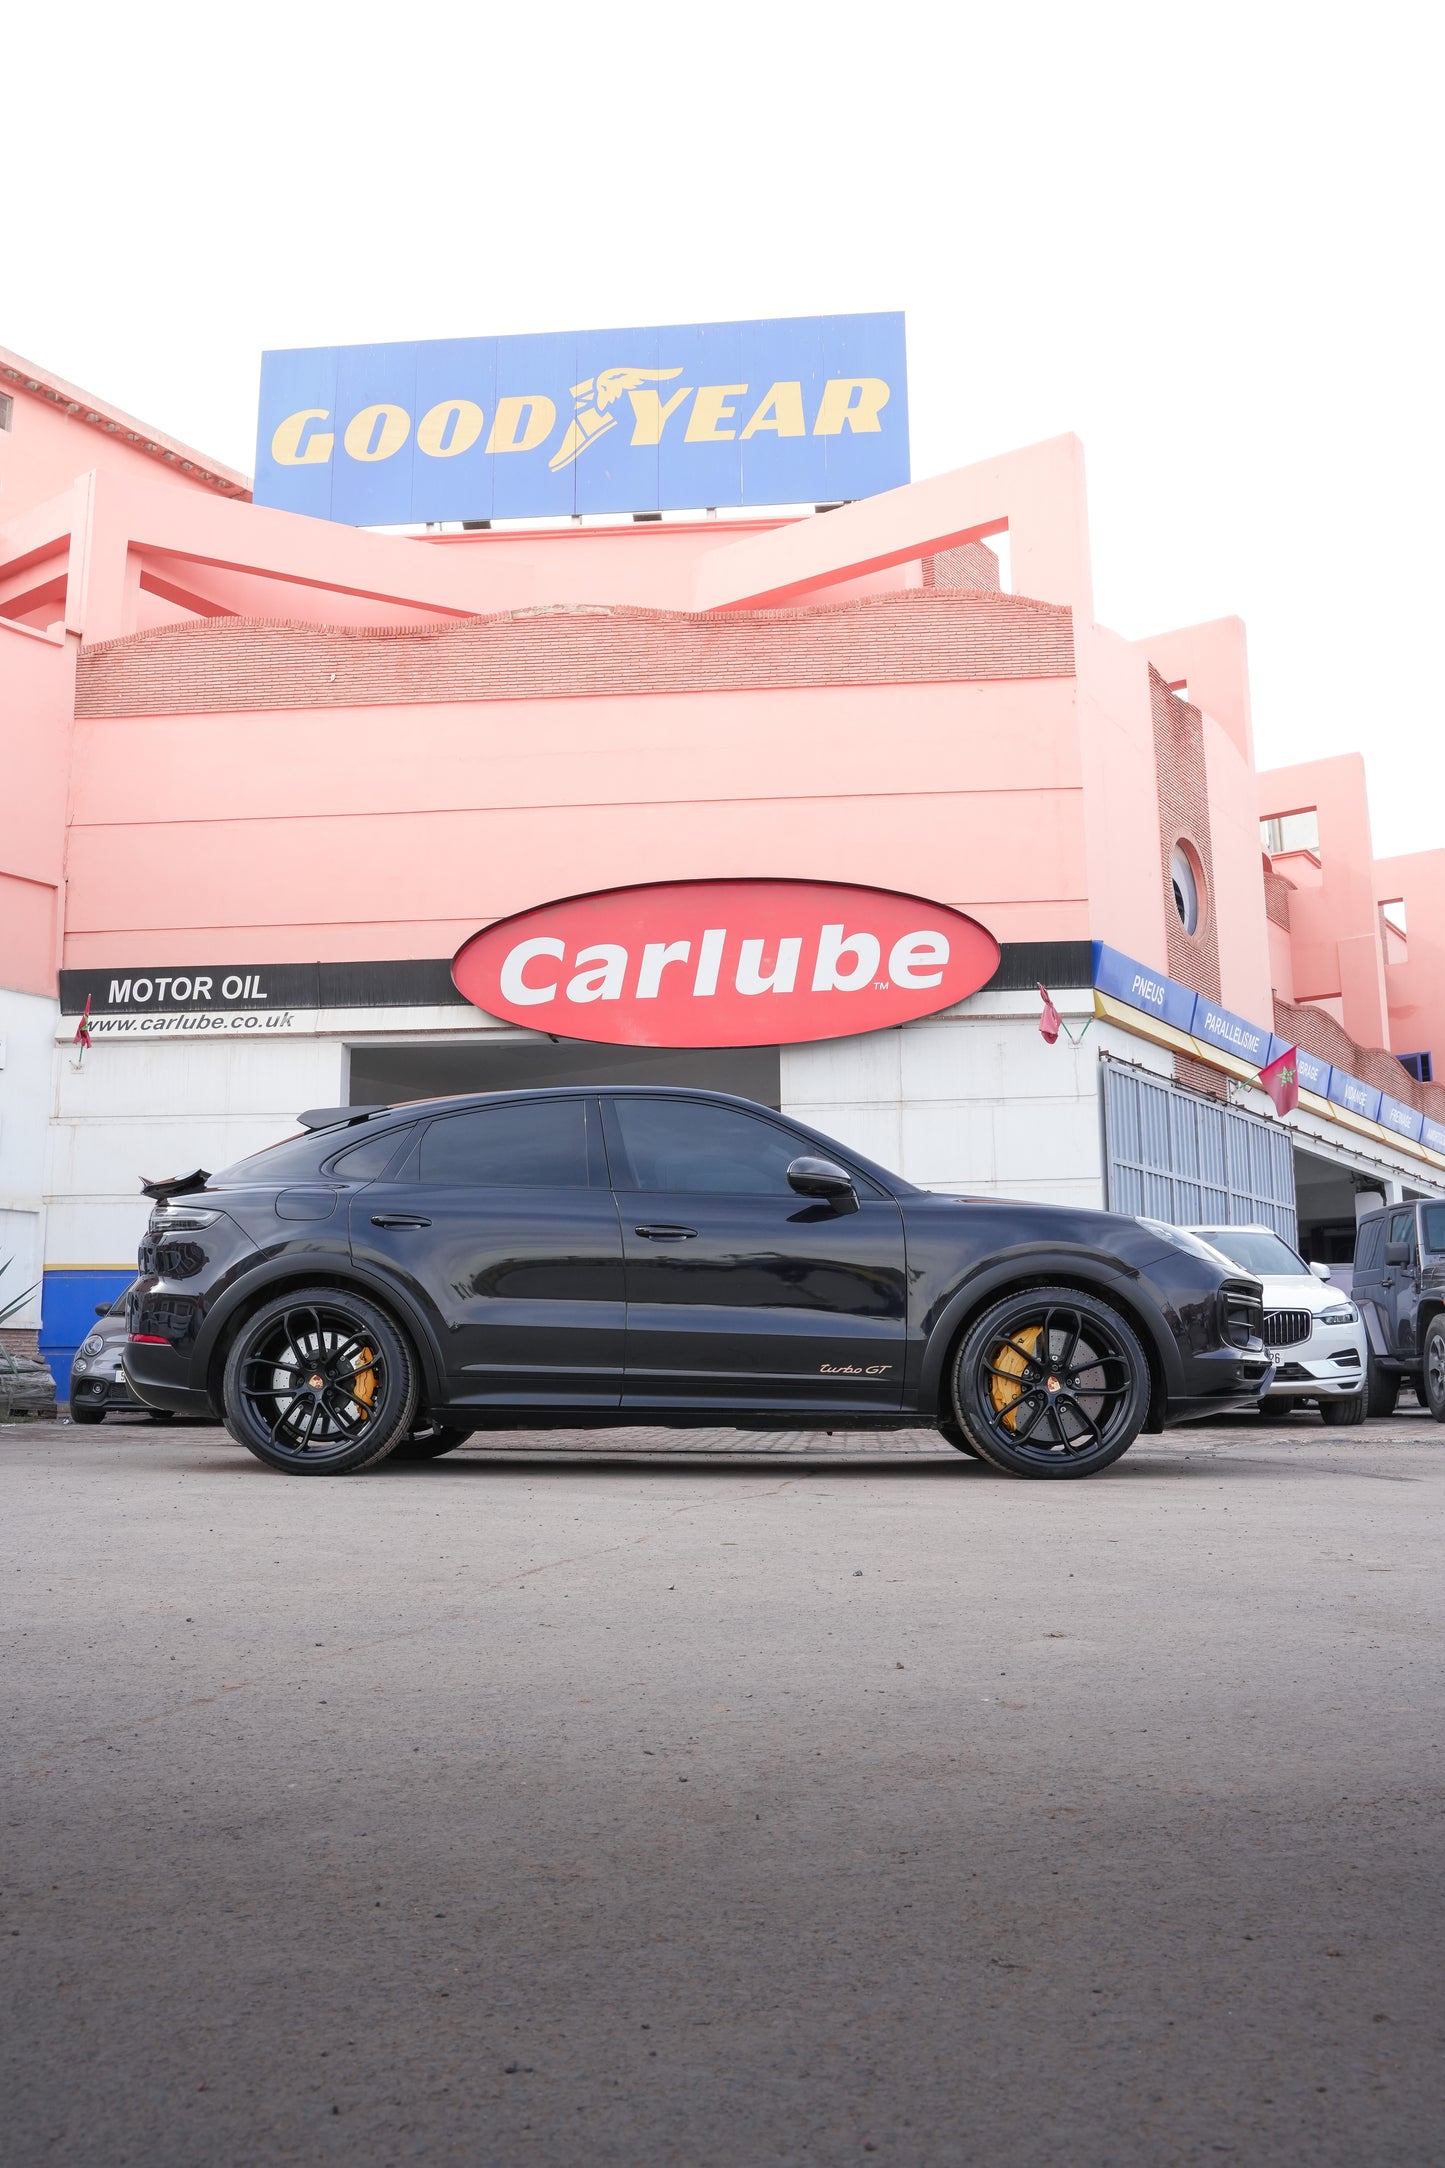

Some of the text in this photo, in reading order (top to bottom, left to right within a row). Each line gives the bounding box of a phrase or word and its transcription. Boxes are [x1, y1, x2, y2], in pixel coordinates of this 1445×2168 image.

[500, 923, 951, 1006] Carlube
[108, 975, 268, 1004] MOTOR OIL
[1131, 974, 1165, 1005] PNEUS
[87, 1011, 295, 1032] www.carlube.co.uk
[1204, 1012, 1260, 1053] PARALLELISME
[865, 1365, 893, 1374] GT
